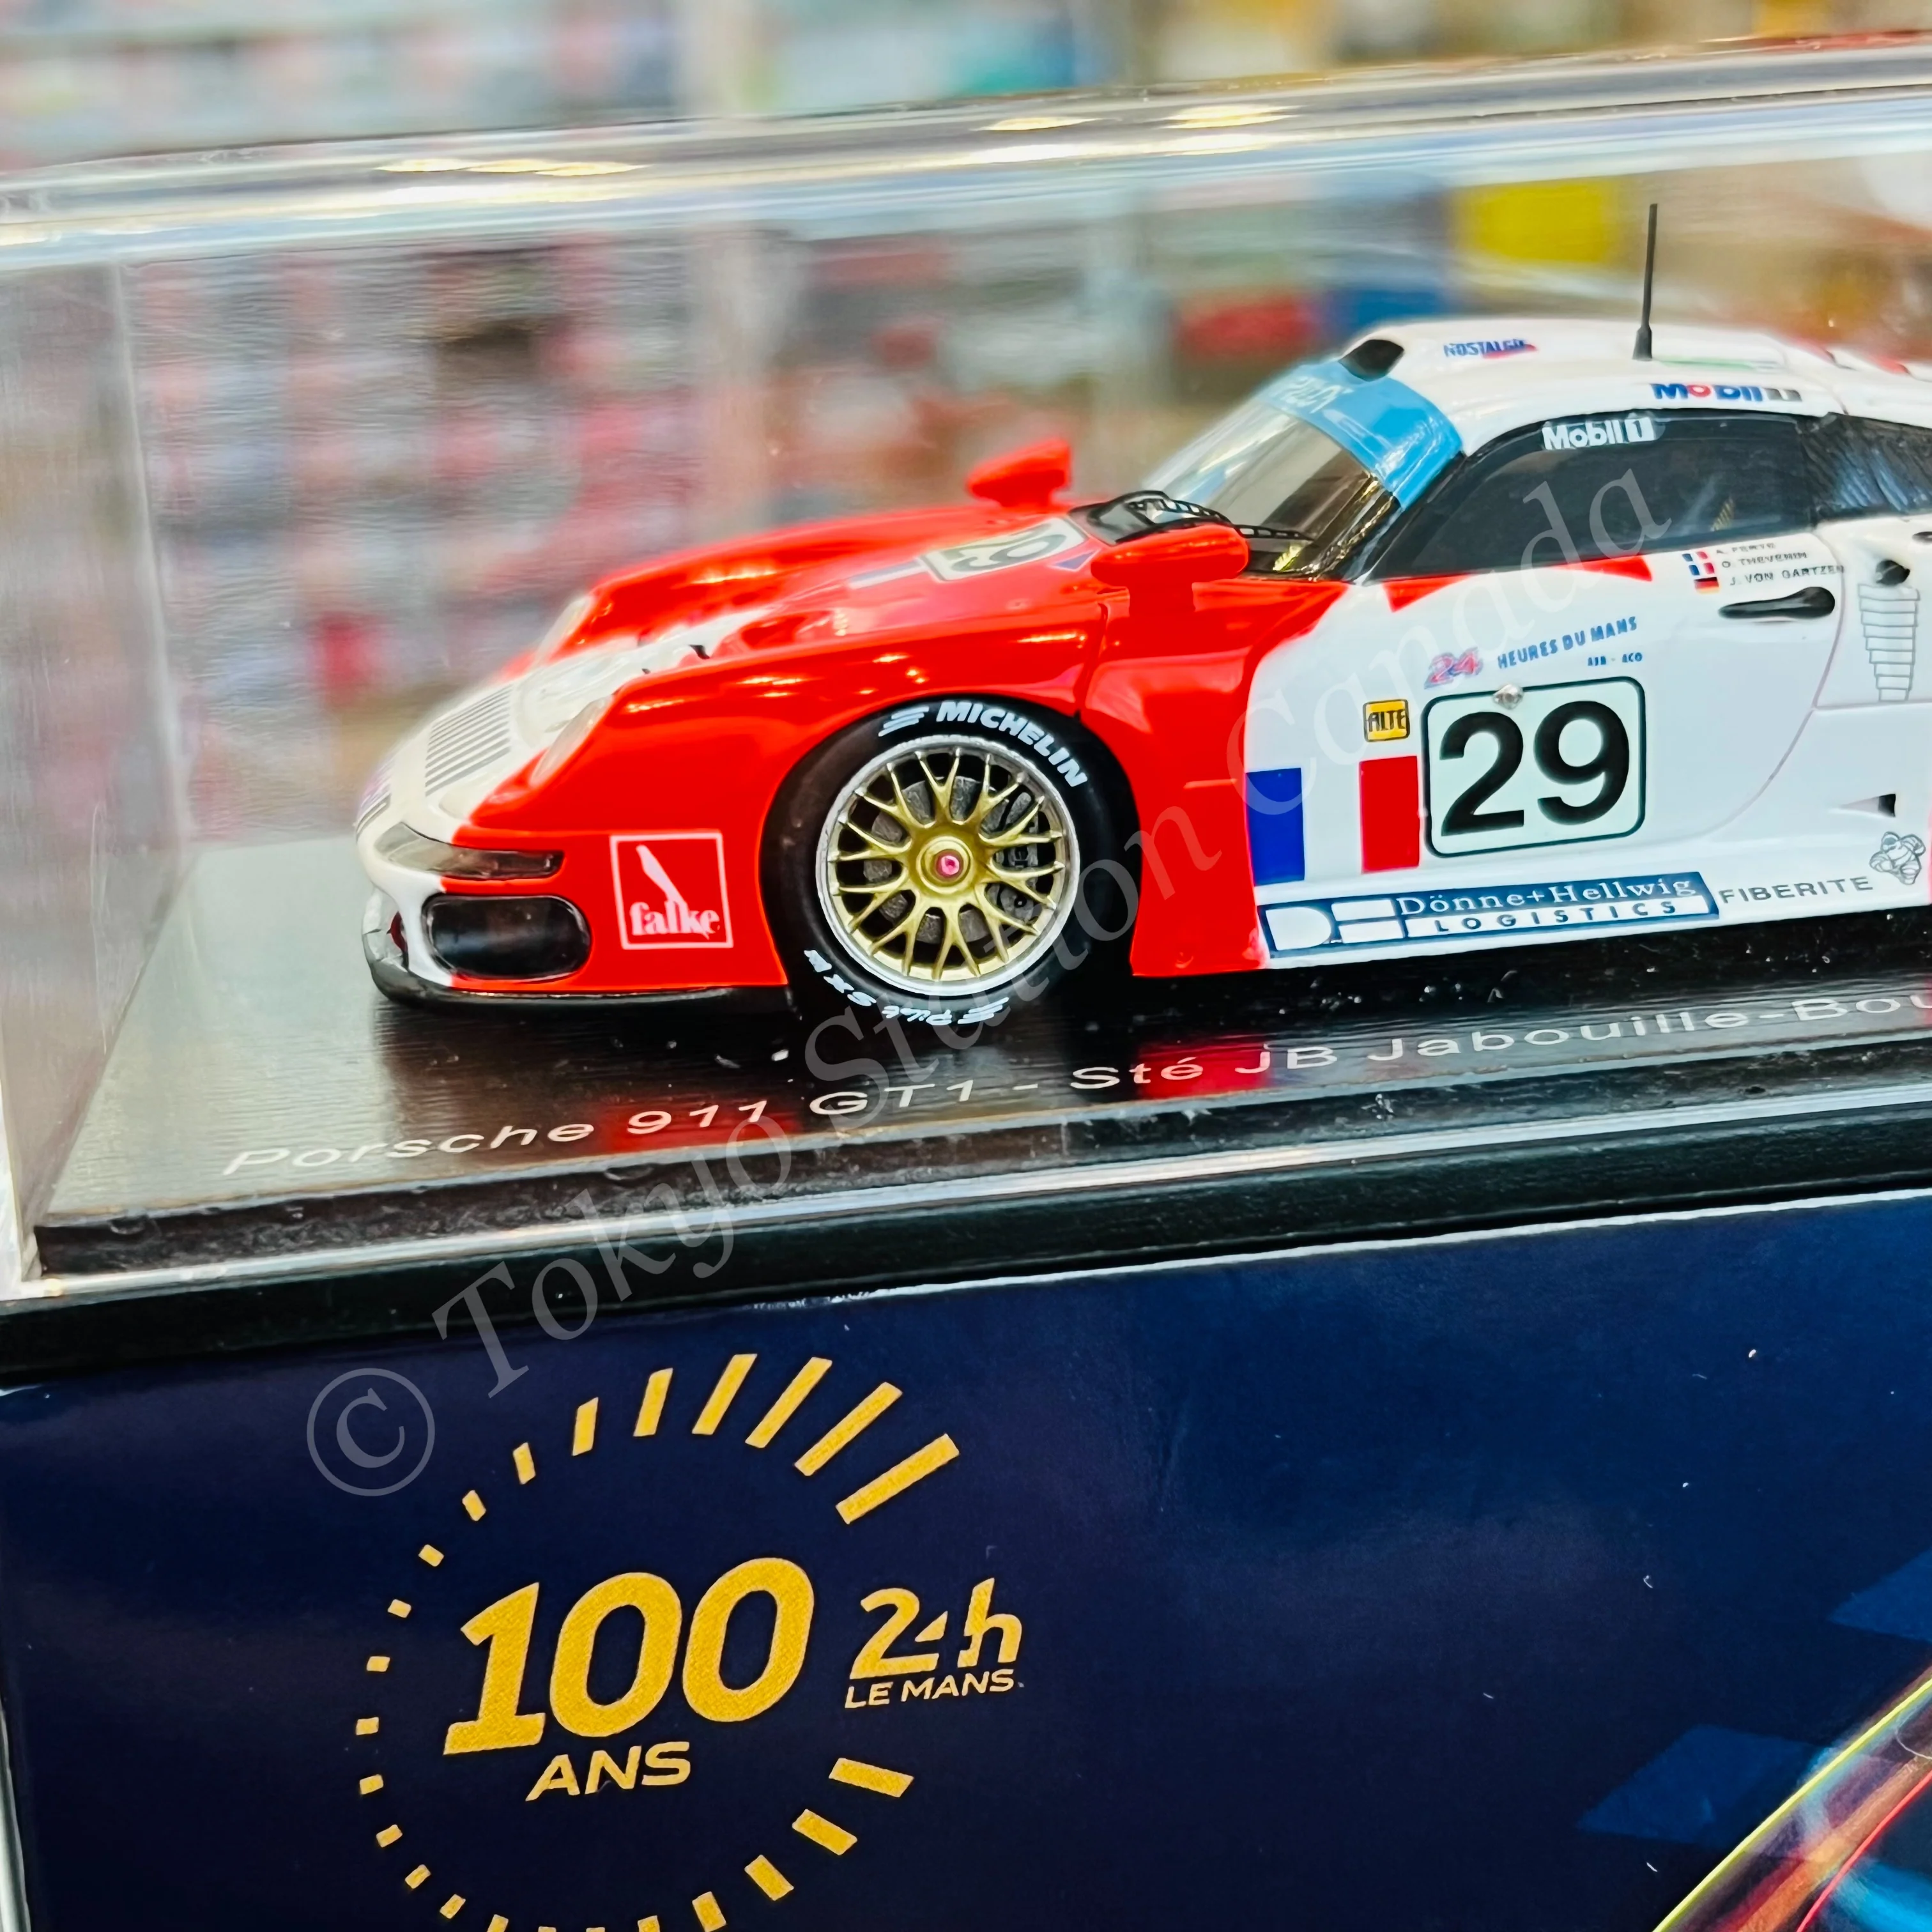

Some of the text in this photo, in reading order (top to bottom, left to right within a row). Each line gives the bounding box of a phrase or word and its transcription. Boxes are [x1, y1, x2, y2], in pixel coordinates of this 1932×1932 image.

[1542, 419, 1623, 450] Mobil
[1424, 616, 1638, 689] 24 HEURES DU MANS
[936, 700, 1088, 788] MICHELIN
[1439, 700, 1630, 837] 29
[629, 896, 720, 940] falke
[1396, 877, 1698, 916] Dönne+Hellwig
[1434, 900, 1676, 933] LOGISTICS
[1719, 876, 1873, 904] FIBERITE
[222, 1121, 596, 1176] Porsche
[626, 1099, 769, 1135] 911
[809, 1078, 974, 1117] GT1
[1070, 1054, 1204, 1091] Sté
[1234, 1045, 1338, 1076] JB
[442, 1556, 816, 1755] 100
[849, 1577, 1023, 1680] 24h
[844, 1668, 1015, 1708] LE MANS
[525, 1740, 691, 1802] ANS
